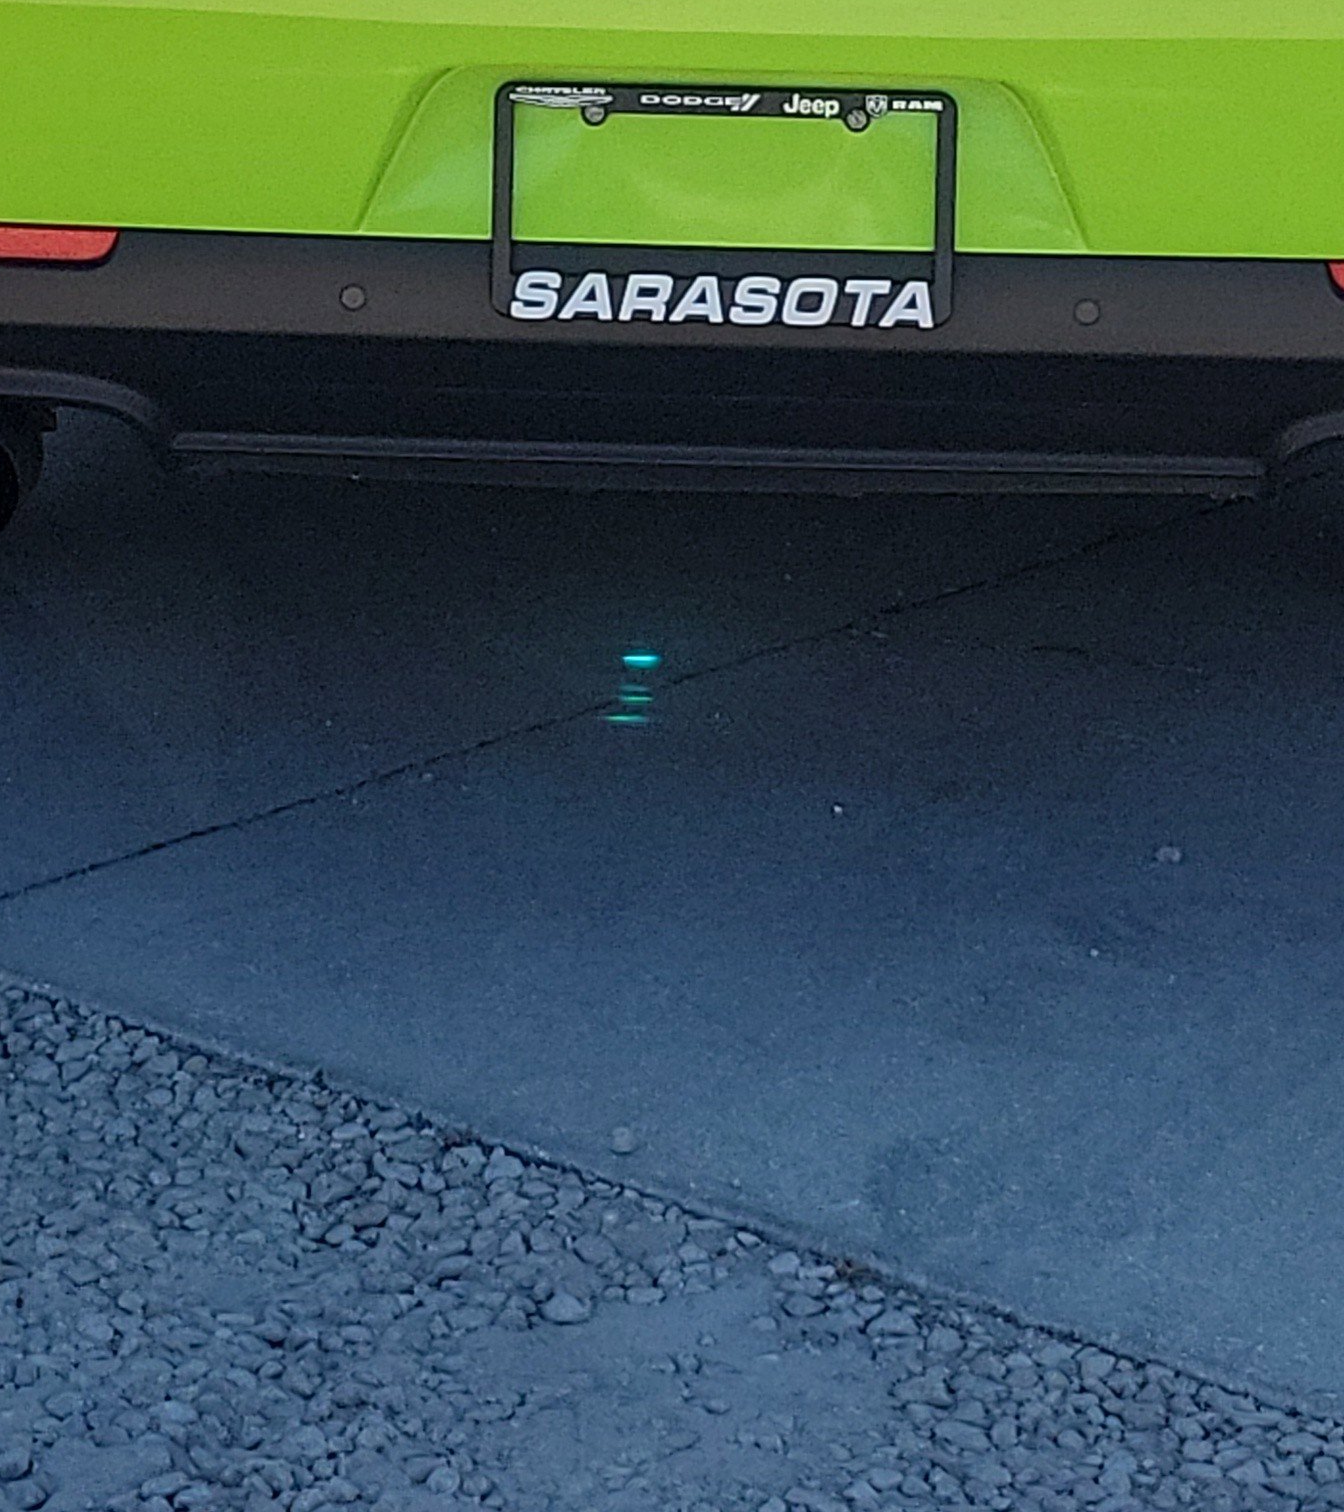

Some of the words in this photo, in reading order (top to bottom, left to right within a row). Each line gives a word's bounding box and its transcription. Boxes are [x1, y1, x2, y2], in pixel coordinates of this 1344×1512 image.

[639, 94, 744, 109] DODGE
[783, 93, 840, 118] Jeep
[891, 100, 944, 112] RAM
[509, 271, 935, 329] SARASOTA
